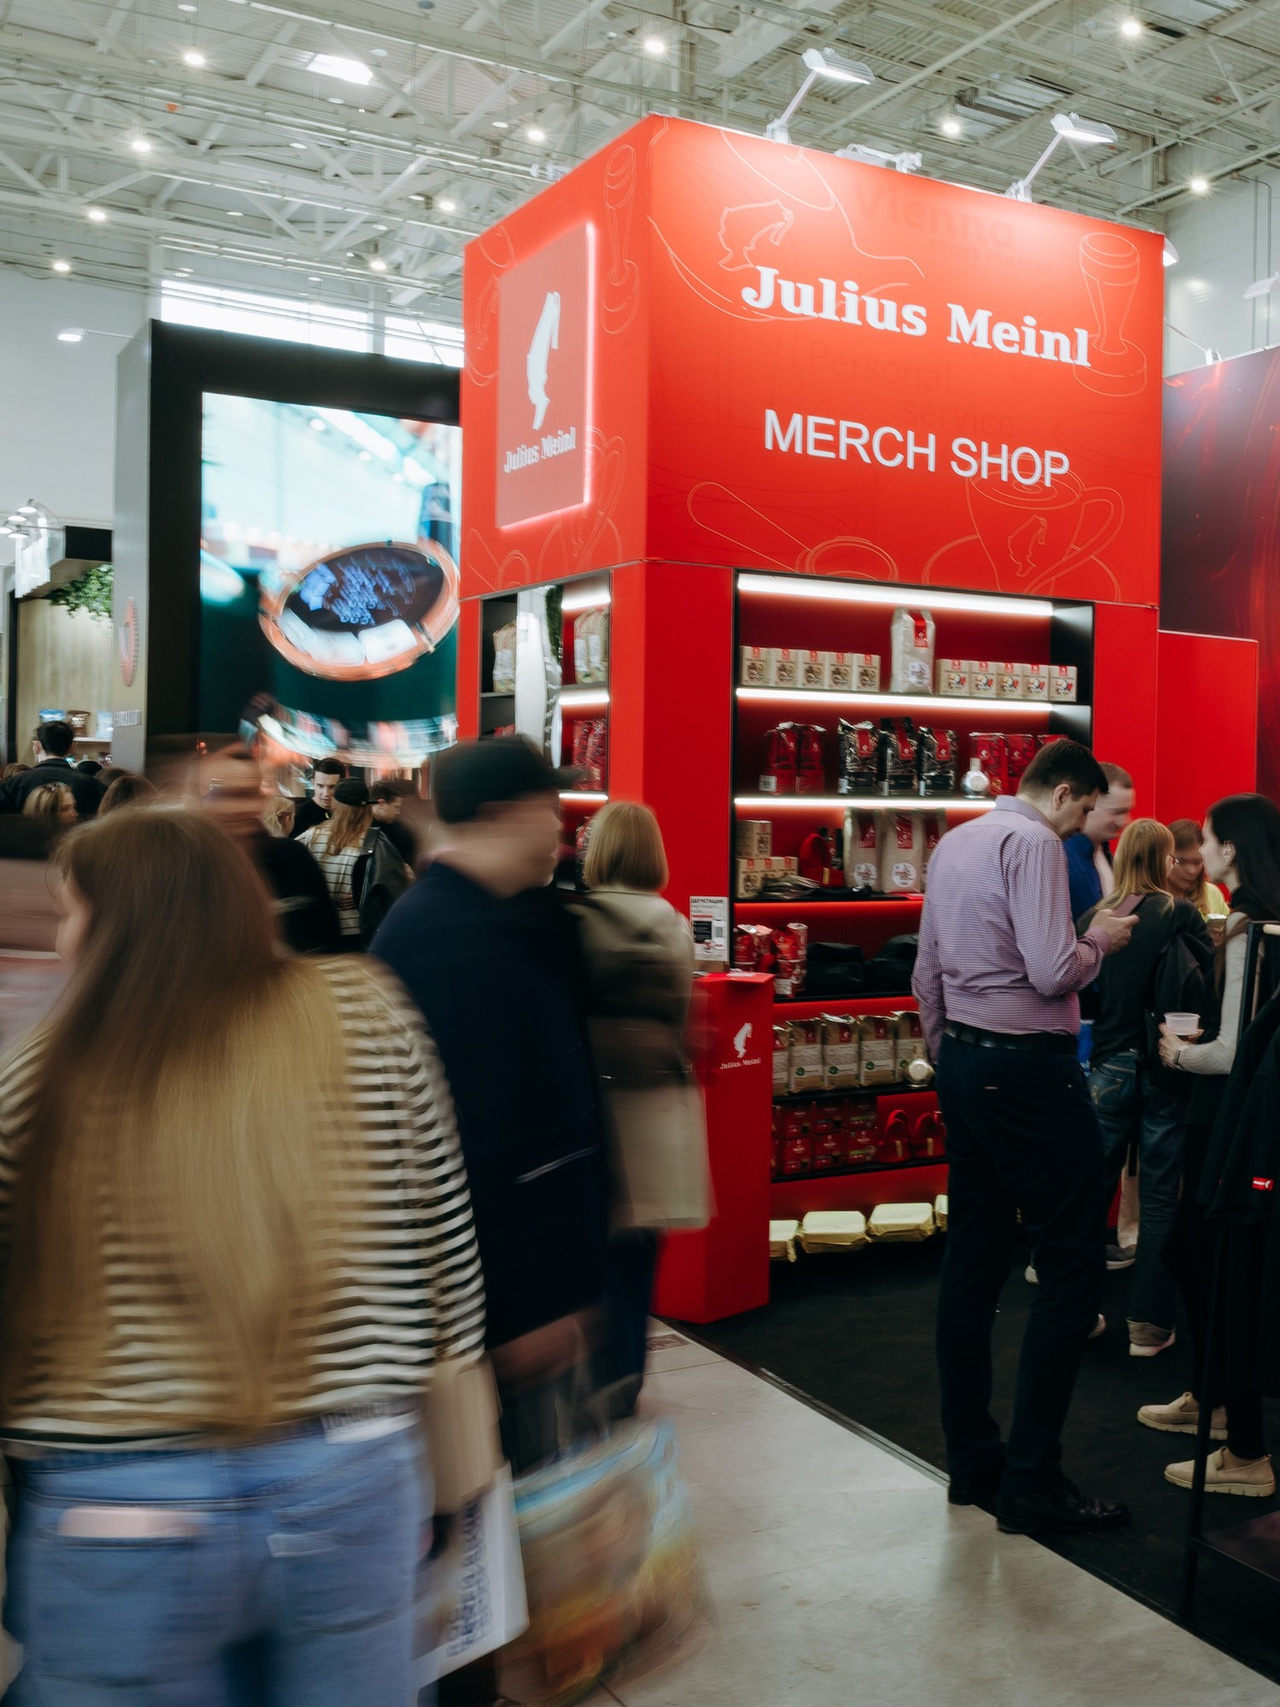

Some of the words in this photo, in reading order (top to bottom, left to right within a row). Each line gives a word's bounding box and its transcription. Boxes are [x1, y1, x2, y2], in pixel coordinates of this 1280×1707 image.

[740, 265, 928, 338] Julius
[945, 302, 1092, 368] Meinl
[503, 444, 540, 474] Julius
[540, 426, 577, 460] Meinl
[764, 408, 937, 474] MERCH
[950, 437, 1071, 488] SHOP
